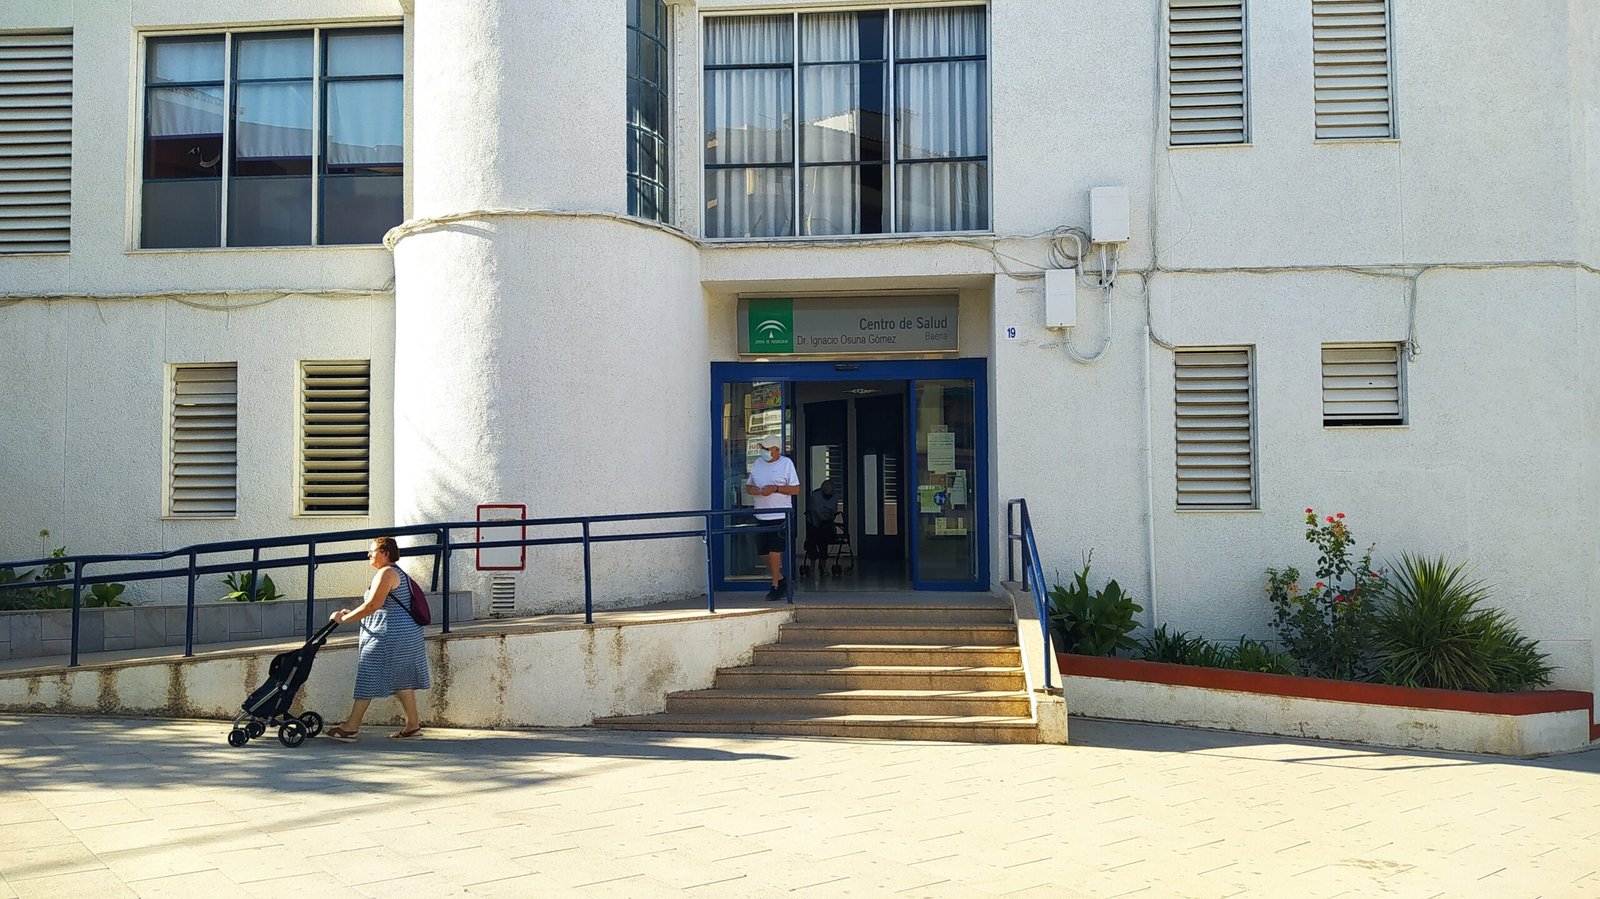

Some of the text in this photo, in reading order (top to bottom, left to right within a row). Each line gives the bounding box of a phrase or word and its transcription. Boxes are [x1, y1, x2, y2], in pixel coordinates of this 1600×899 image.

[859, 316, 948, 331] Centro de Salud
[925, 331, 948, 341] Baena
[1006, 327, 1016, 339] 19
[797, 335, 808, 345] Dr.
[810, 335, 838, 347] Ignacio
[840, 335, 866, 345] Osuna
[868, 333, 897, 344] Gómez
